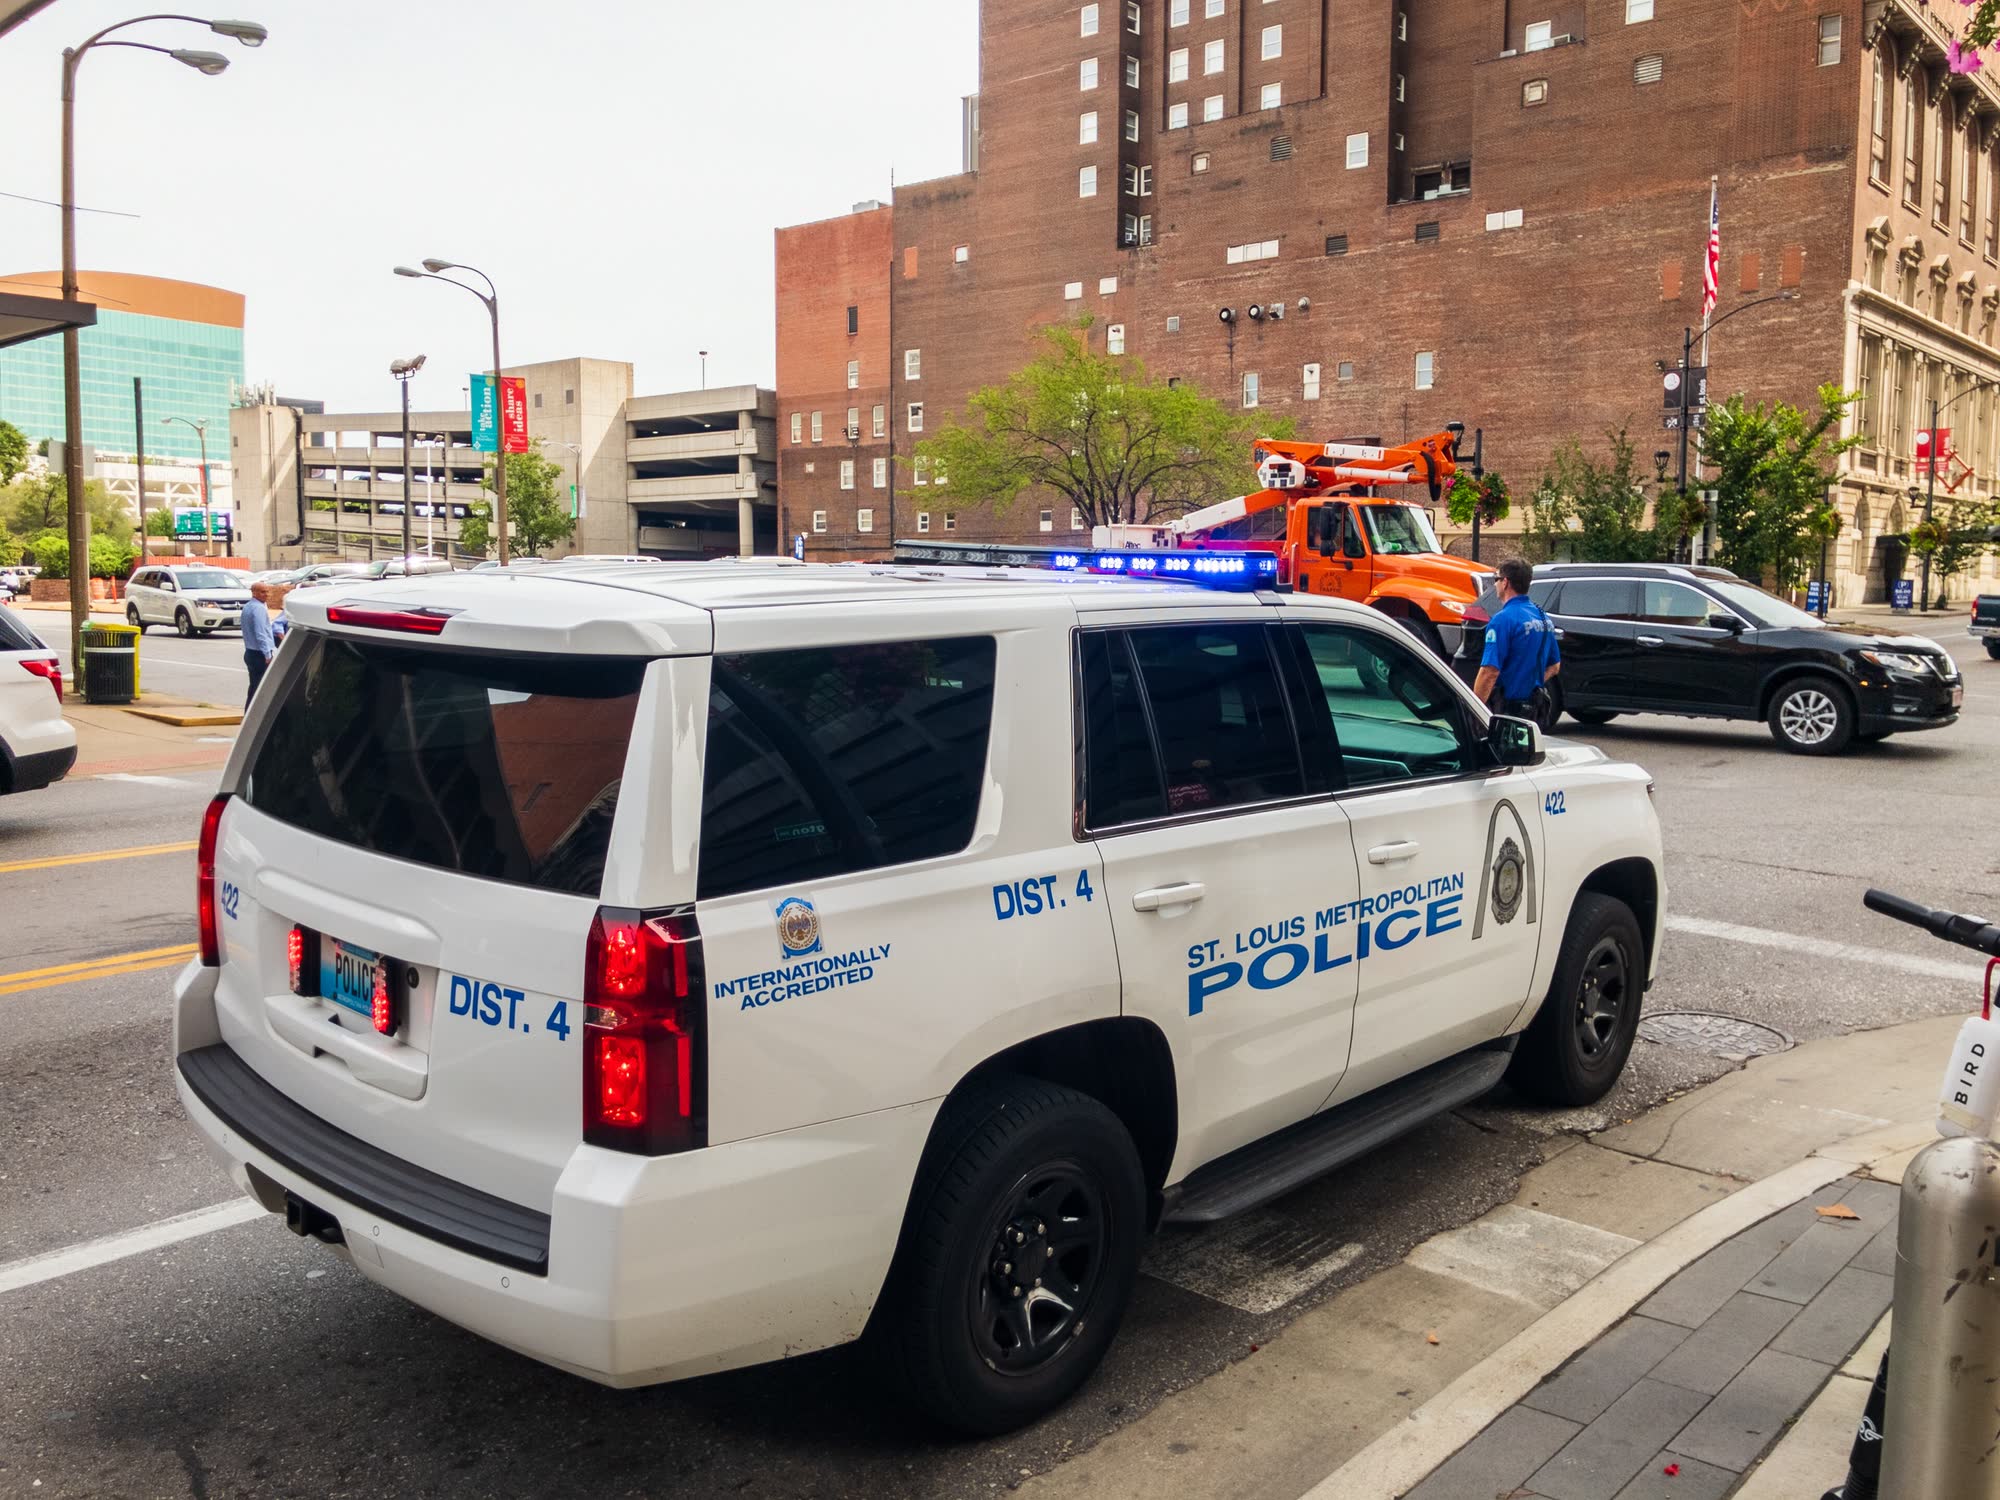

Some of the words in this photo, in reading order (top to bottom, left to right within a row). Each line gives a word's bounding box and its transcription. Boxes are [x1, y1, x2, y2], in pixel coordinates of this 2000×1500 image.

[480, 387, 493, 429] action
[505, 388, 515, 419] share
[513, 401, 524, 432] ideas
[1544, 791, 1566, 816] 422
[221, 880, 239, 920] 422
[993, 875, 1067, 921] DIST.
[1076, 869, 1094, 902] 4
[1188, 939, 1225, 969] ST.
[1236, 915, 1306, 954] LOUIS
[1315, 872, 1464, 930] METROPOLITAN
[714, 943, 891, 999] INTERNATIONALLY
[1188, 893, 1464, 1017] POLICE
[449, 975, 530, 1033] DIST.
[546, 1000, 571, 1042] 4
[740, 965, 874, 1011] ACCREDITED
[1953, 1043, 1985, 1105] BIRD
